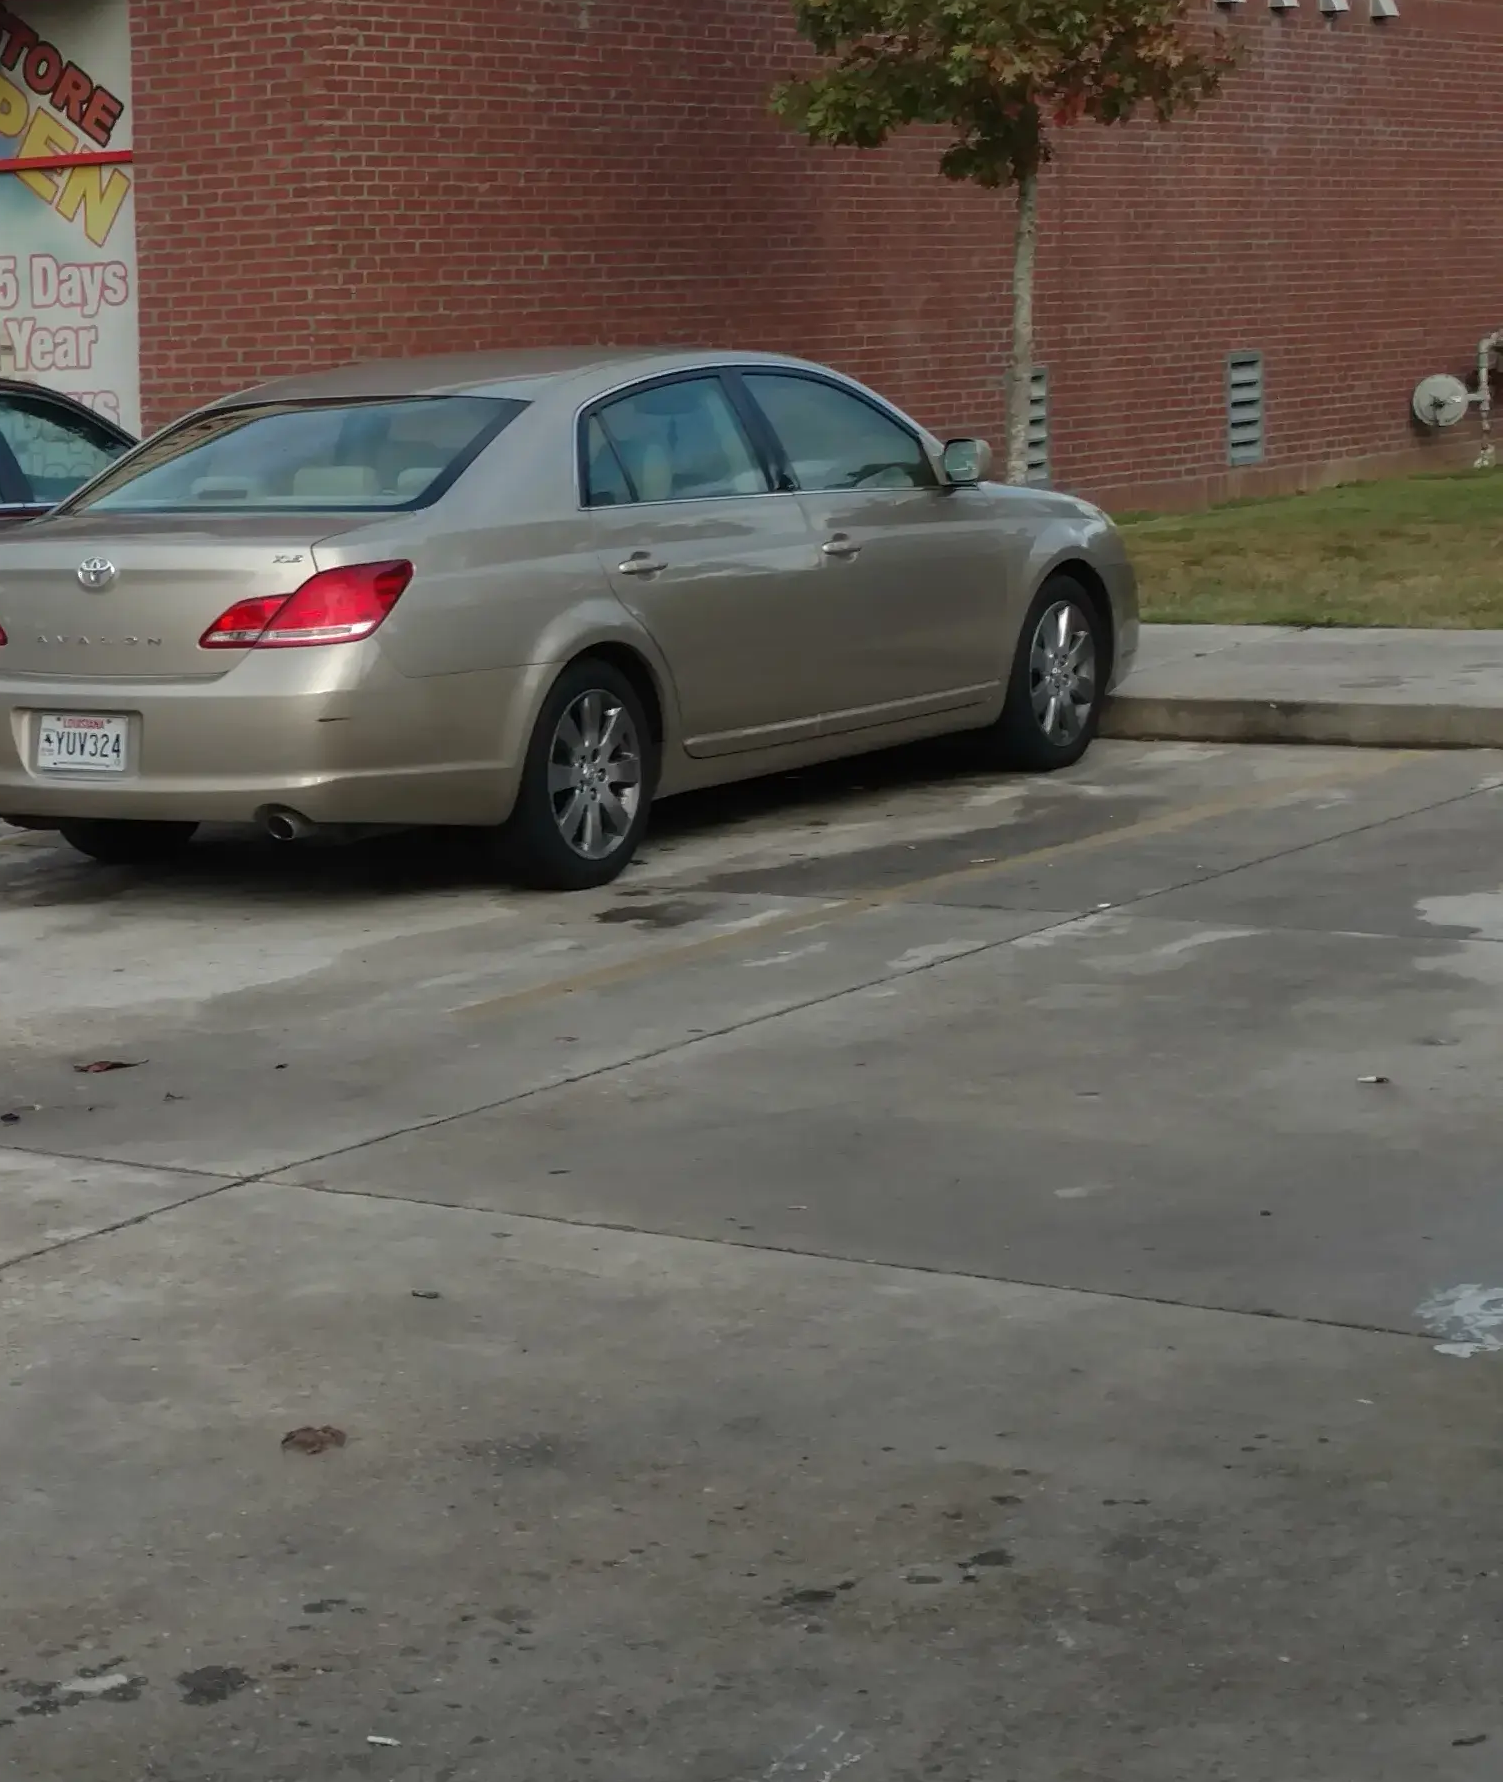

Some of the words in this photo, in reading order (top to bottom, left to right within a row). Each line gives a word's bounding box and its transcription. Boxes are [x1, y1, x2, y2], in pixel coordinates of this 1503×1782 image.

[29, 253, 129, 318] Days
[3, 316, 99, 372] Year
[36, 635, 163, 646] AVALON
[56, 730, 122, 759] YUV324
